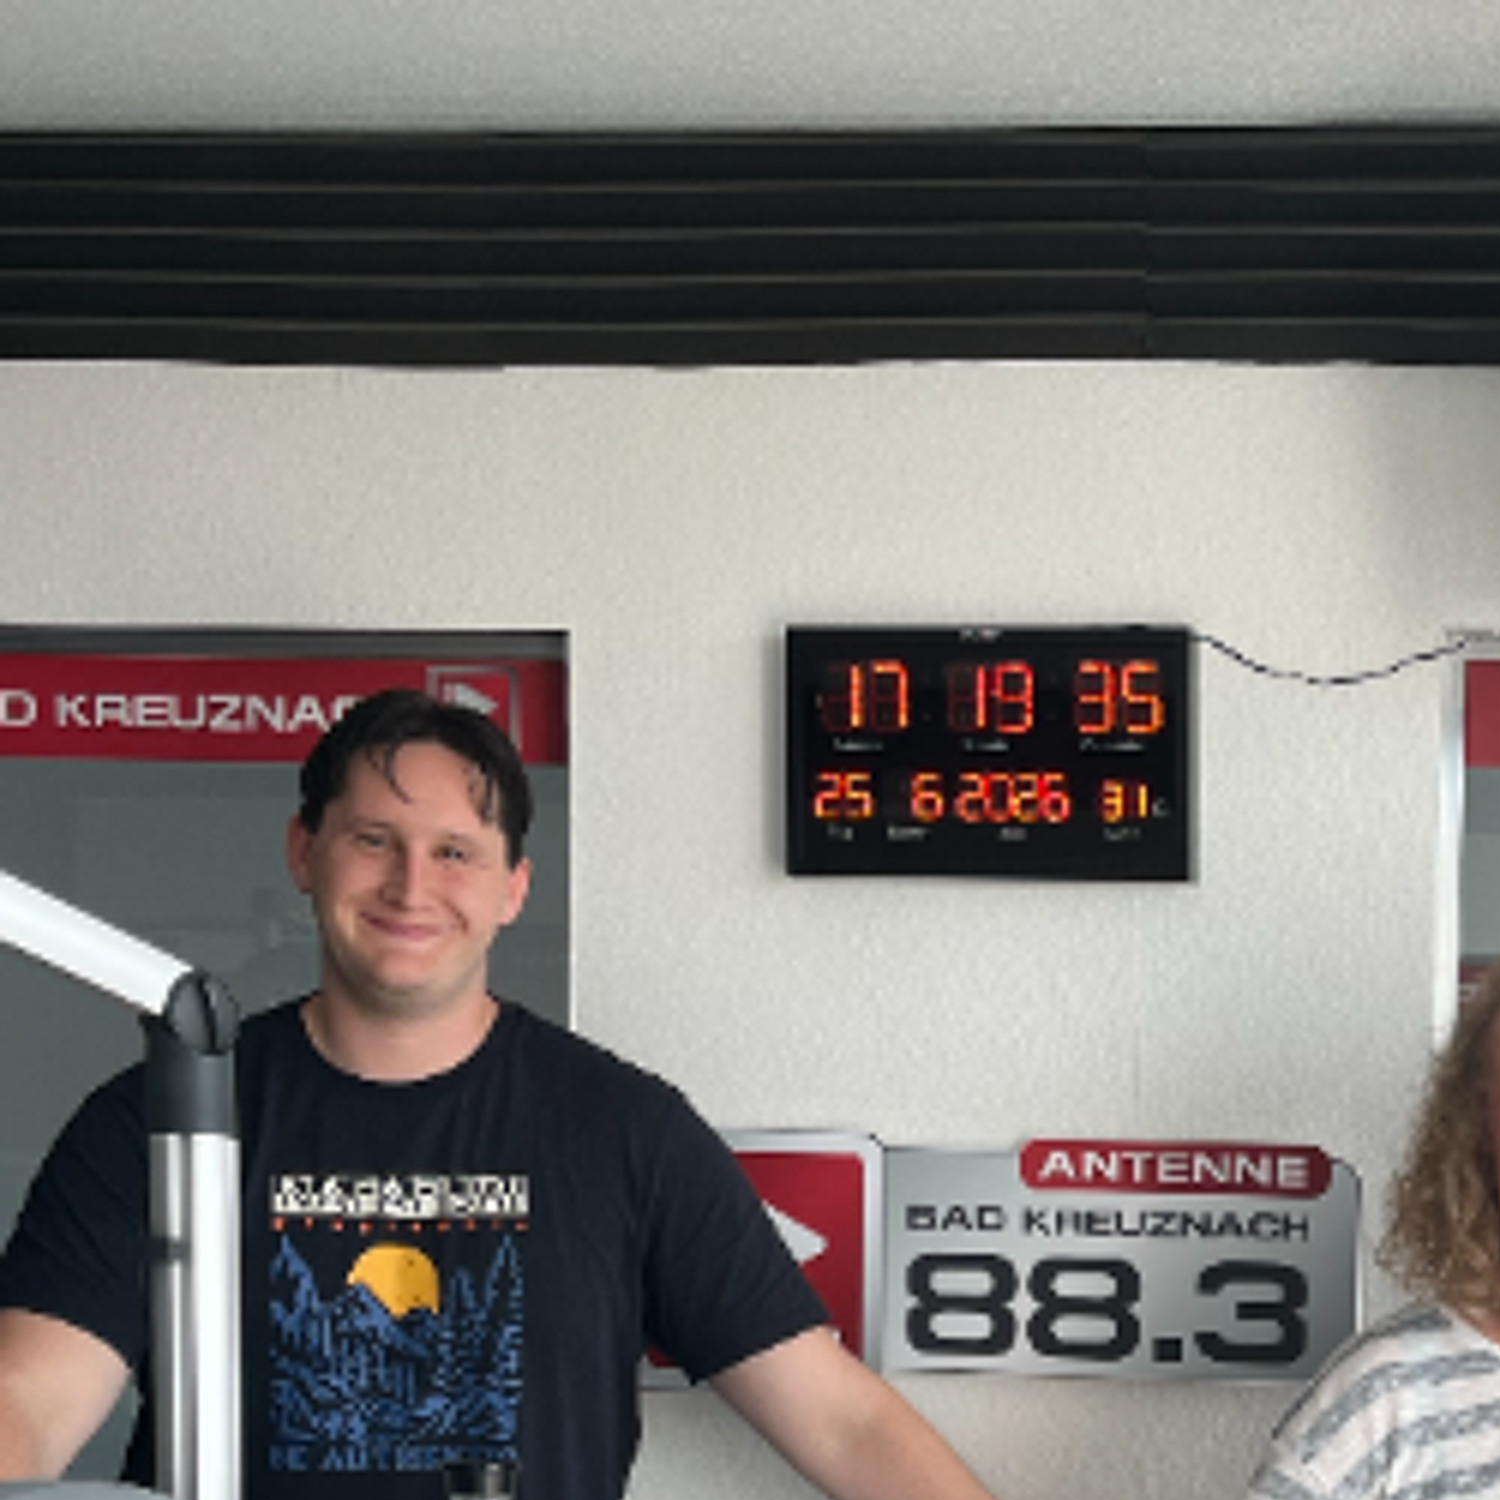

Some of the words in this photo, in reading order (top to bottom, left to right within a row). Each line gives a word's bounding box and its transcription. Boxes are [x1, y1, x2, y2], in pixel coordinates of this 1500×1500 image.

[847, 659, 910, 729] 17
[974, 659, 1035, 734] 19
[1076, 660, 1166, 734] 35
[813, 771, 876, 820] 25
[910, 771, 945, 823] 6
[953, 771, 1072, 824] 2026
[1100, 780, 1149, 822] 31
[1036, 1148, 1311, 1189] ANTENNE
[905, 1204, 1008, 1234] BAD
[1022, 1205, 1311, 1241] KREUZNACH
[905, 1252, 1311, 1366] 88.3
